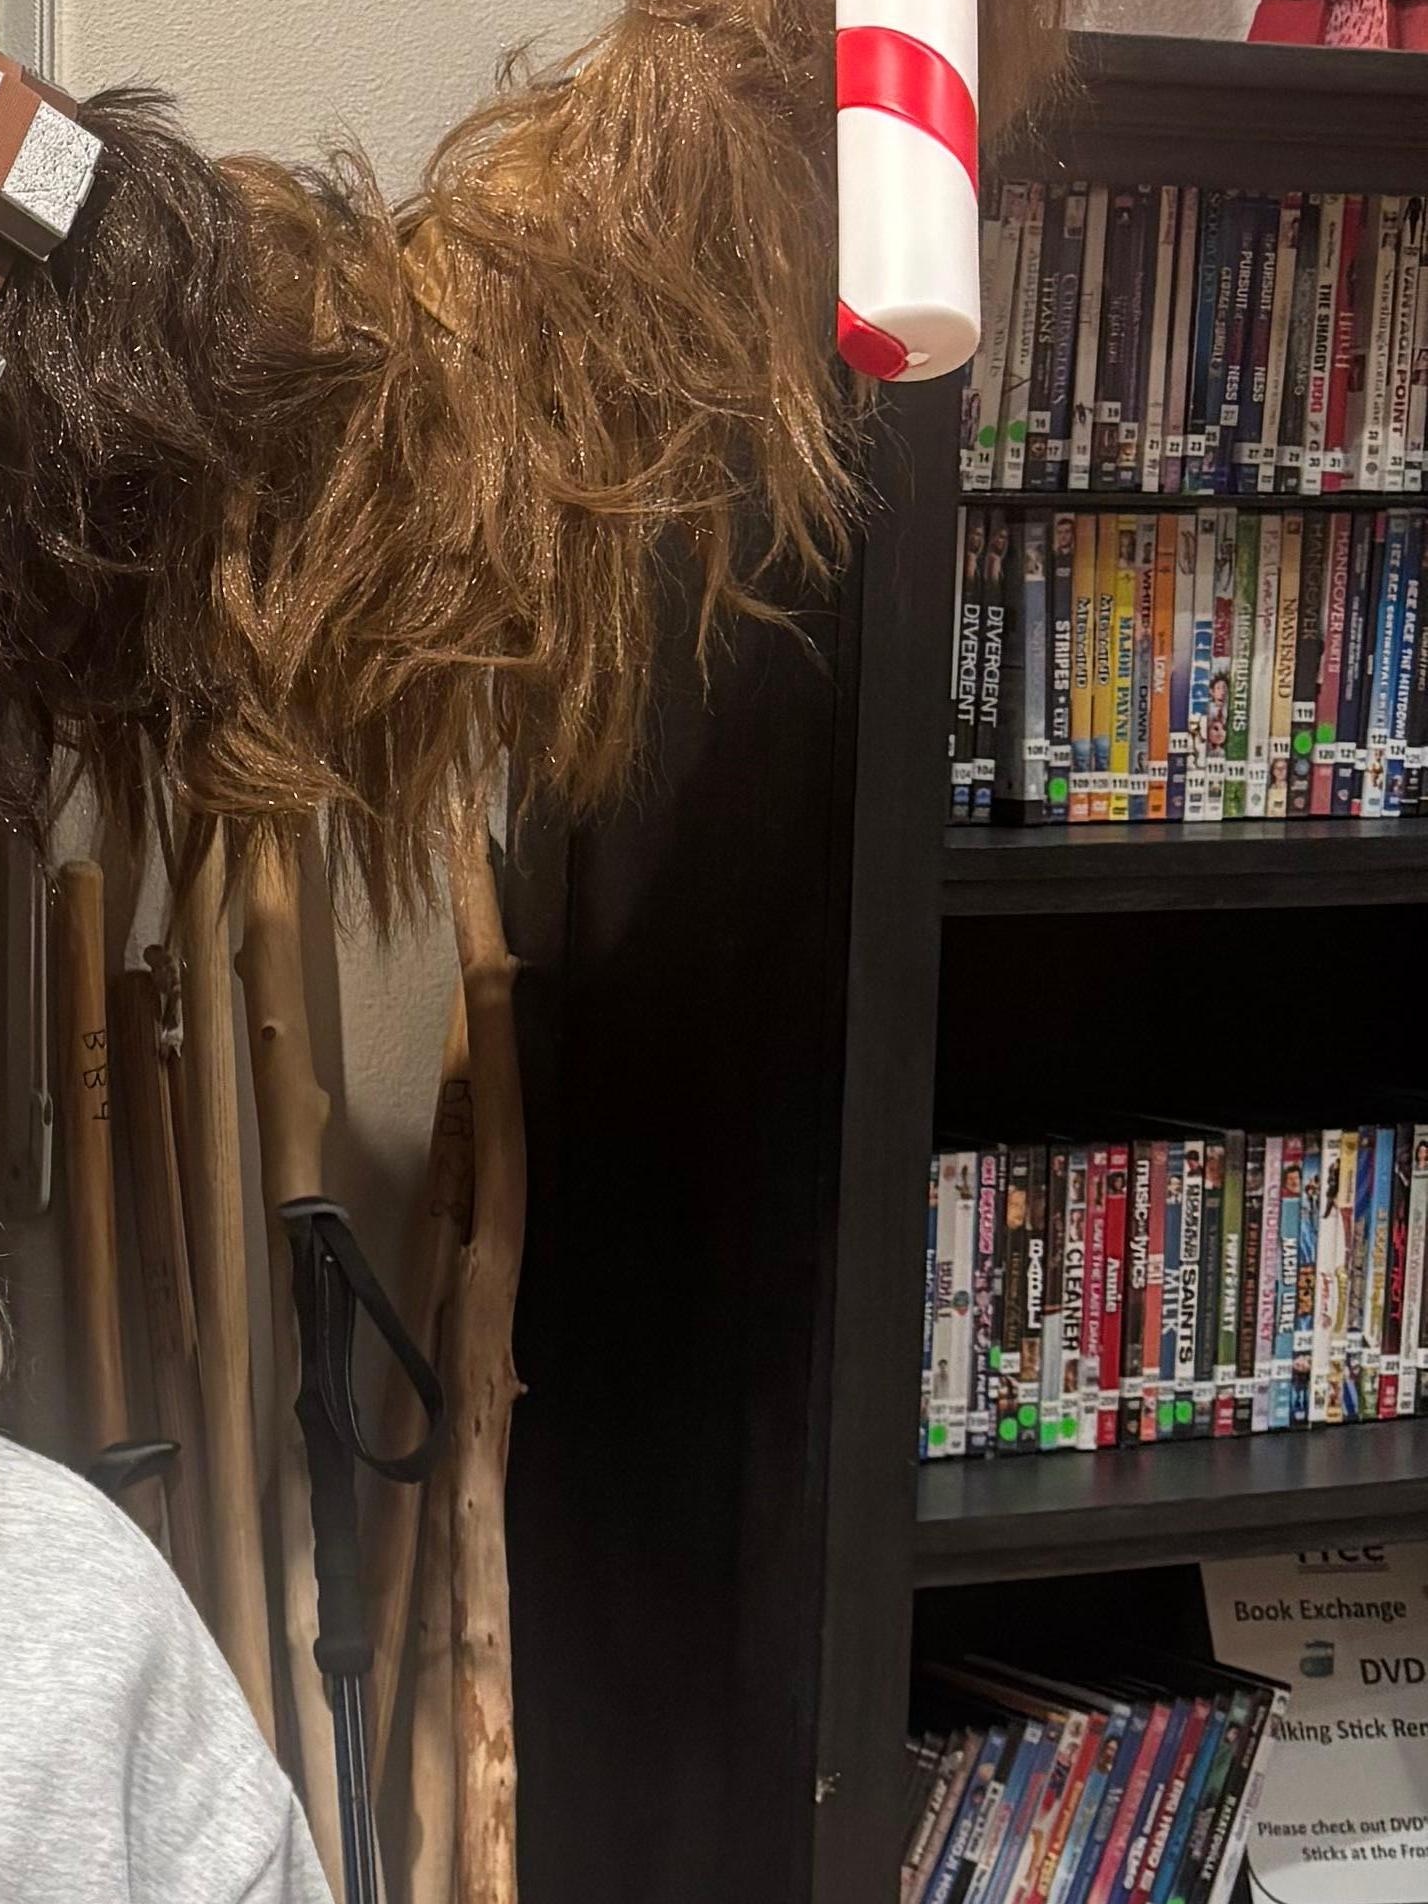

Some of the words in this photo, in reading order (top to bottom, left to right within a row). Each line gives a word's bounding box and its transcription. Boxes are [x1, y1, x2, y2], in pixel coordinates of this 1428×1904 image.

[1234, 250, 1253, 309] PURSUIT
[1259, 252, 1275, 310] PURSUIT
[1319, 284, 1331, 309] THE
[1038, 276, 1056, 344] TITANS
[1397, 266, 1412, 366] VANTAGE
[1313, 314, 1331, 373] SHAGGY
[1310, 376, 1325, 412] DOG
[1392, 369, 1409, 436] POINT
[1302, 523, 1323, 640] HANGOVER
[1330, 531, 1350, 633] HANGOVER
[1388, 543, 1401, 568] ICE
[1386, 573, 1401, 601] AGE
[1406, 579, 1420, 608] ICE
[1053, 620, 1071, 691] STRIPES
[1117, 617, 1132, 678] MAJOR
[1194, 621, 1212, 660] ICE
[1380, 605, 1396, 687] CONTINENTAL
[1402, 612, 1418, 642] AGE
[957, 604, 980, 727] DIVERGENT
[981, 606, 1005, 728] DIVERGENT
[1232, 603, 1252, 732] GHOSTBUSTERS
[1400, 648, 1413, 671] THE
[1115, 686, 1131, 743] PAYNE
[1137, 685, 1148, 742] DOWN
[1394, 673, 1412, 738] MELTDOWN
[1134, 1160, 1150, 1220] music
[1104, 1257, 1121, 1313] Annie
[1129, 1235, 1148, 1289] lyrics
[1282, 1237, 1298, 1285] NACHO
[1062, 1249, 1083, 1351] CLEANER
[1161, 1268, 1180, 1335] MILK
[1179, 1268, 1197, 1364] SAINTS
[1279, 1292, 1296, 1334] LIBRE
[1234, 1599, 1294, 1622] Book
[1299, 1596, 1407, 1626] Exchange
[1359, 1657, 1426, 1685] DVD
[1337, 1717, 1387, 1740] Stick
[1257, 1820, 1307, 1838] Please
[1311, 1819, 1355, 1836] check
[1360, 1819, 1387, 1834] out
[1301, 1845, 1347, 1862] Sticks
[1351, 1845, 1367, 1860] at
[1371, 1843, 1397, 1859] the
